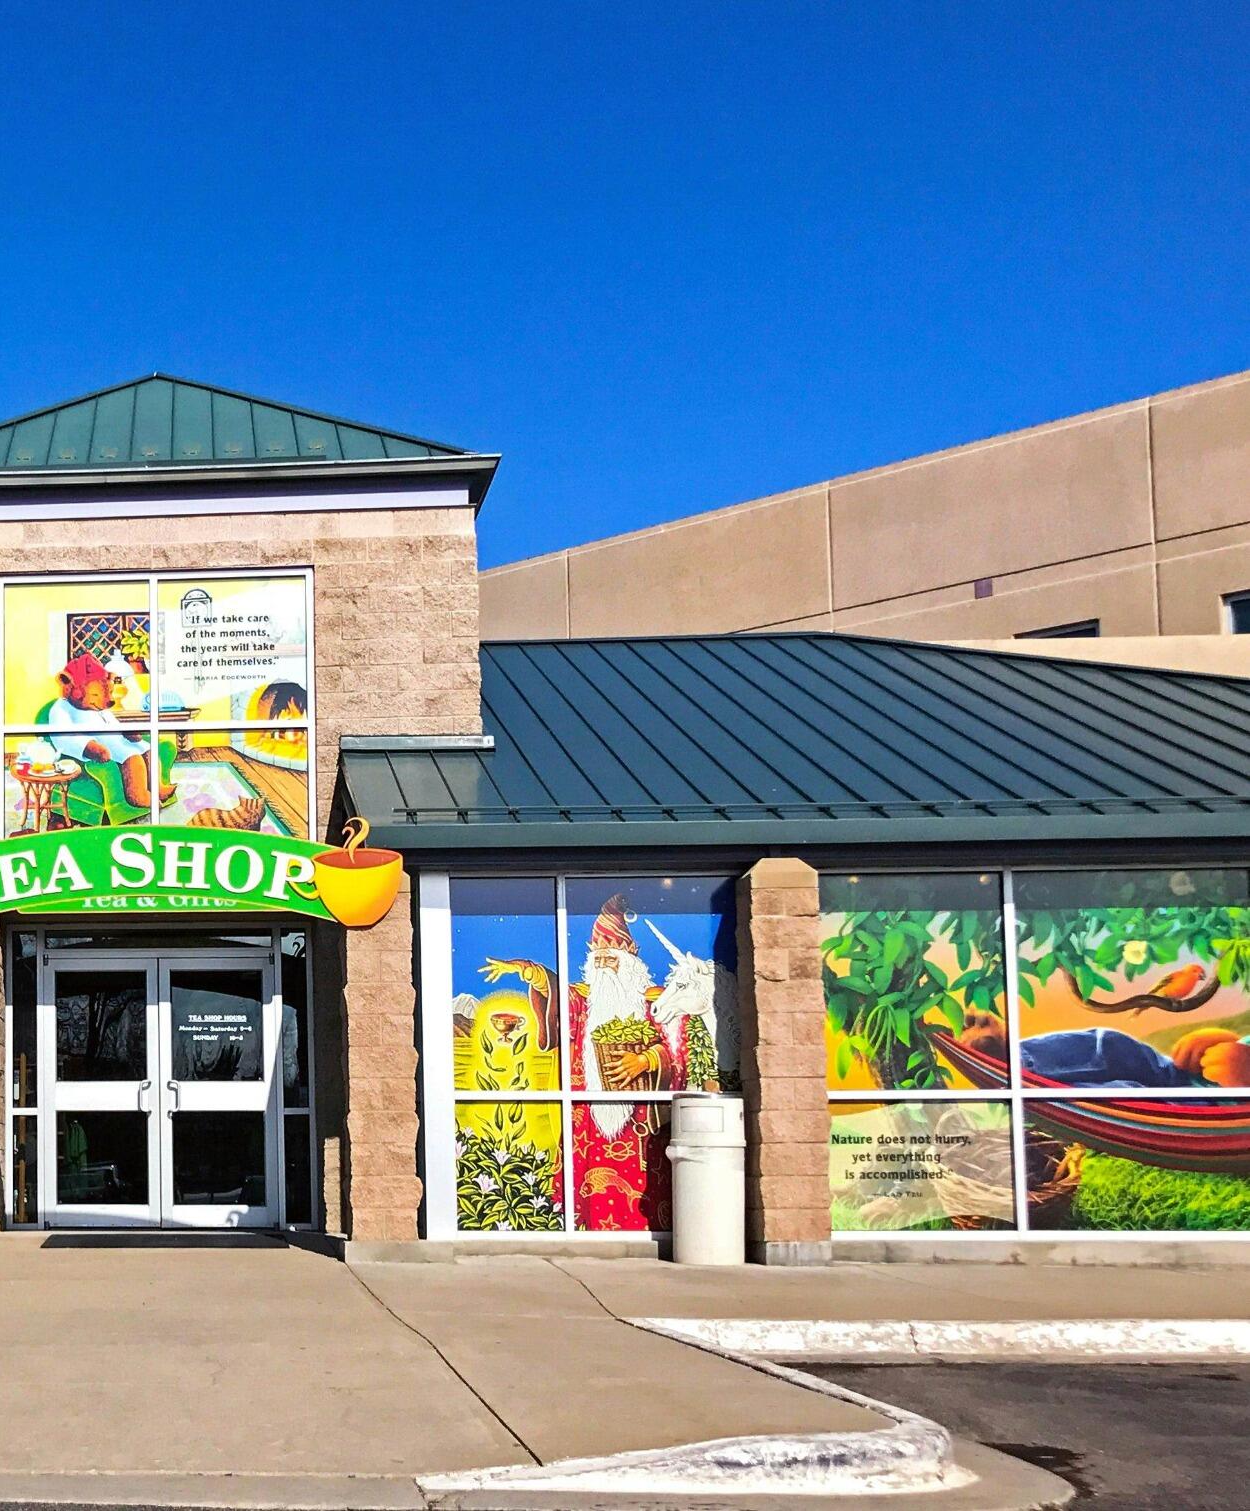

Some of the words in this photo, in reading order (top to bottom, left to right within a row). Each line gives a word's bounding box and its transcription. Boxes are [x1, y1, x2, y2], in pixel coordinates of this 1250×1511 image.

[222, 615, 244, 623] take
[185, 630, 197, 638] of
[200, 630, 216, 638] the
[220, 629, 270, 638] moments,
[181, 645, 197, 653] the
[200, 645, 227, 655] years
[231, 643, 249, 652] will
[253, 643, 275, 651] take
[202, 659, 212, 667] of
[110, 833, 315, 901] SHOP
[82, 895, 128, 908] Tea
[137, 895, 158, 908] &
[831, 1134, 873, 1144] Nature
[877, 1134, 906, 1144] does
[910, 1134, 931, 1144] not
[935, 1134, 972, 1145] hurry,
[852, 1152, 871, 1164] yet
[876, 1152, 941, 1164] everything
[845, 1170, 855, 1179] is
